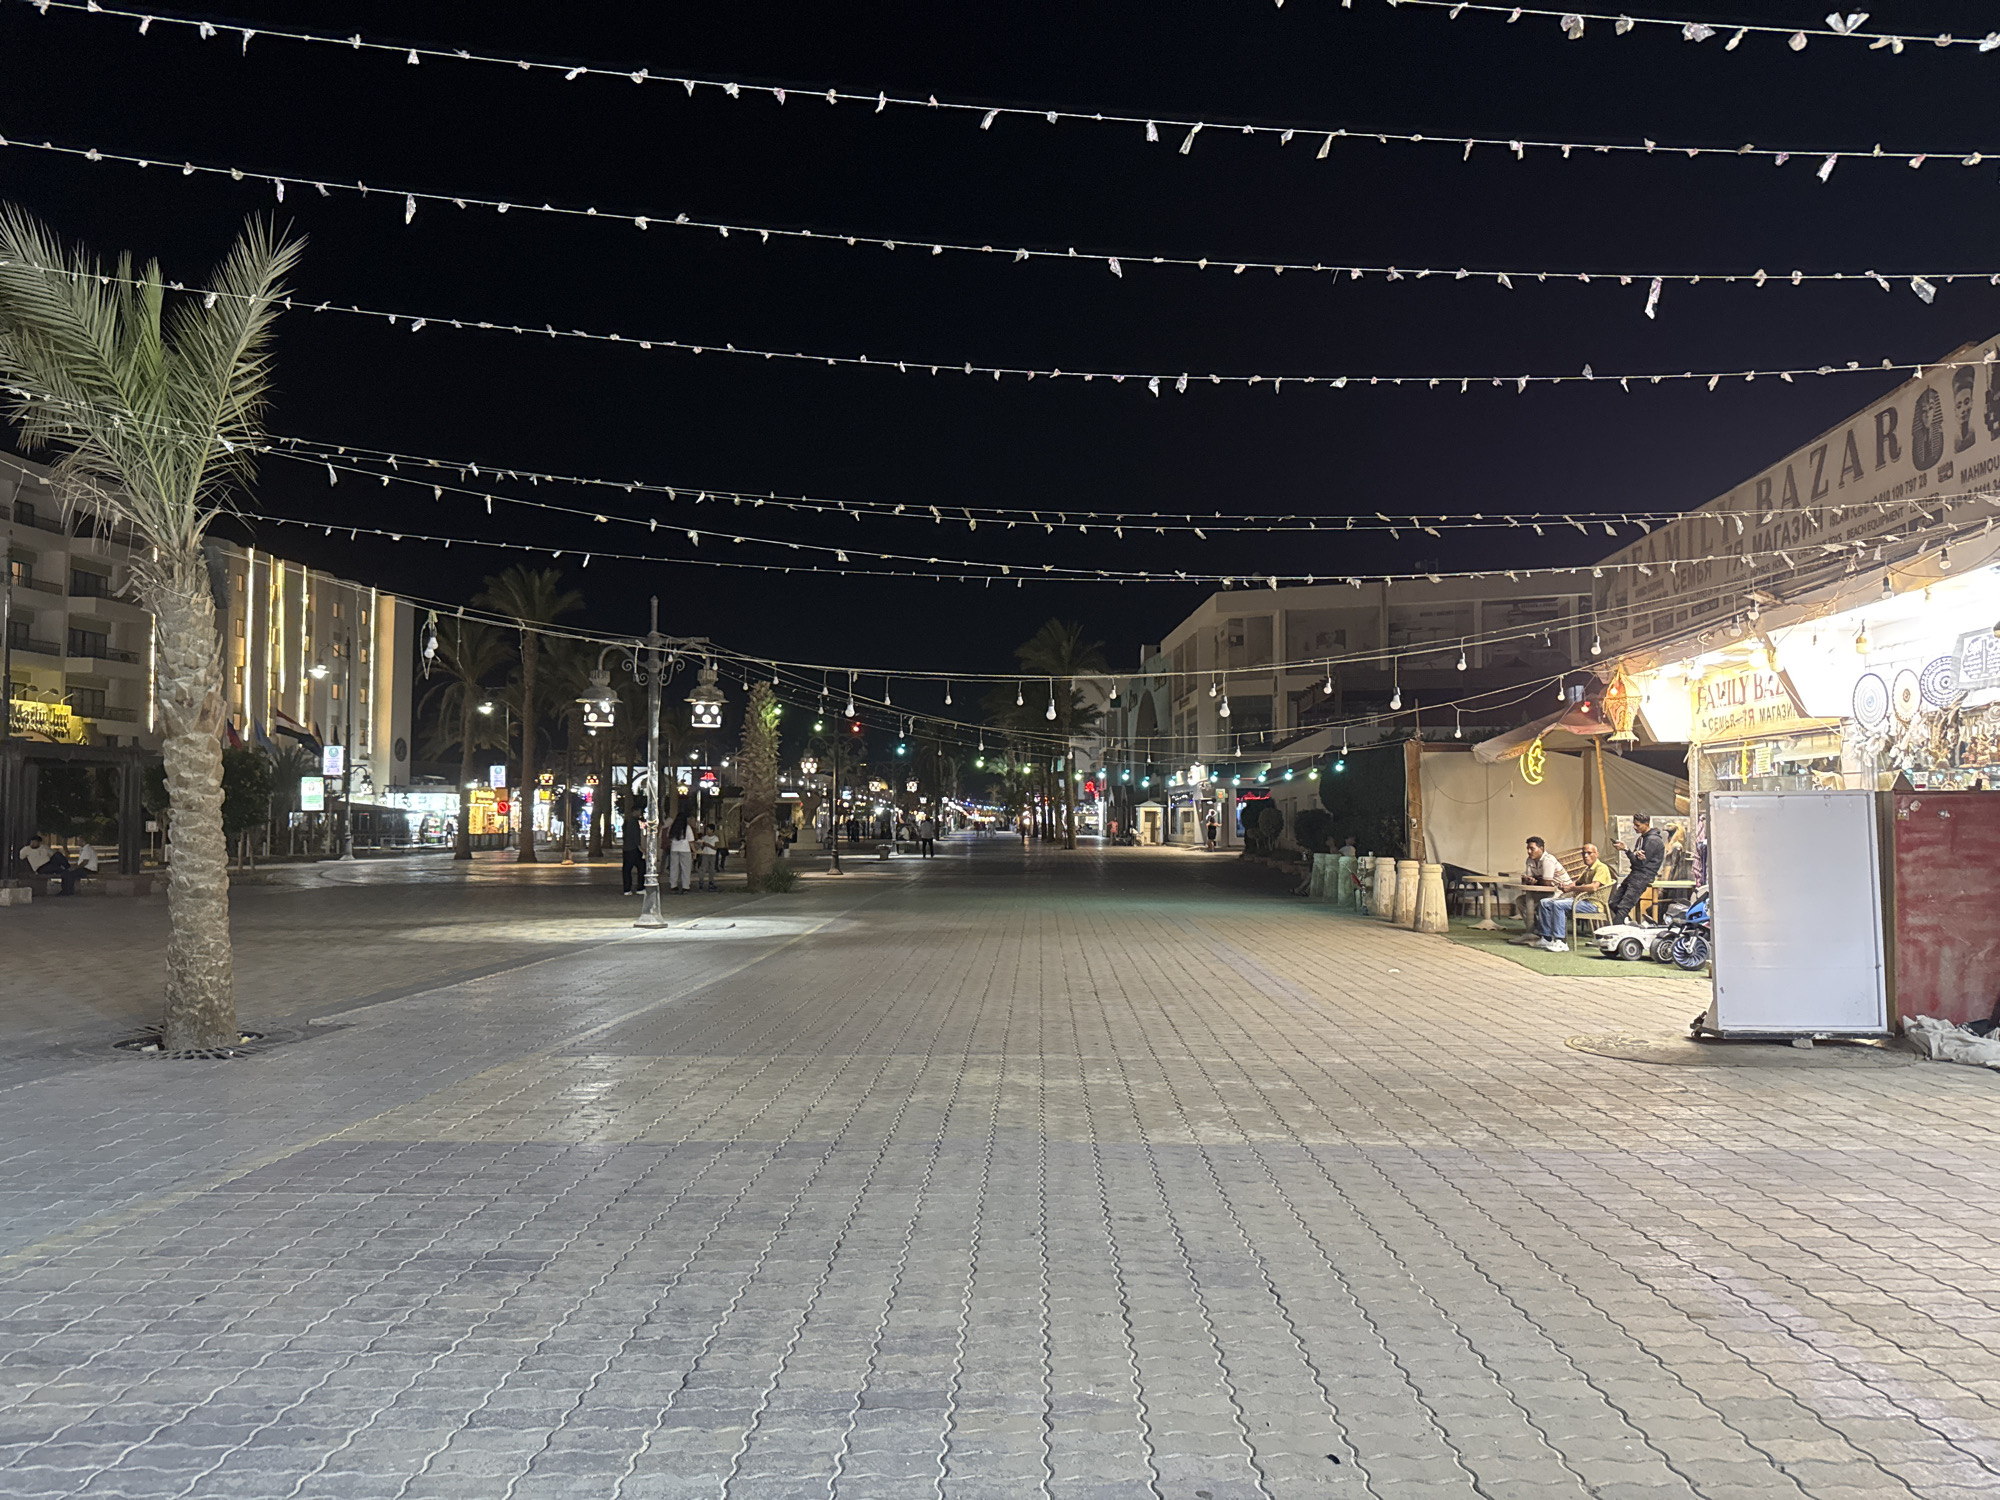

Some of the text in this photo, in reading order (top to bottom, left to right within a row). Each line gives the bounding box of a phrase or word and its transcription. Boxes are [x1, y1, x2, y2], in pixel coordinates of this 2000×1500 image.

[1632, 406, 1902, 587] FAMILY BAZAR
[1905, 477, 1917, 495] 797
[1867, 506, 1905, 532] EQUIPMENT
[1672, 559, 1712, 595] СЕМЬЯ
[1752, 504, 1824, 554] МАГАЗИН
[1753, 673, 1785, 702] BAZ
